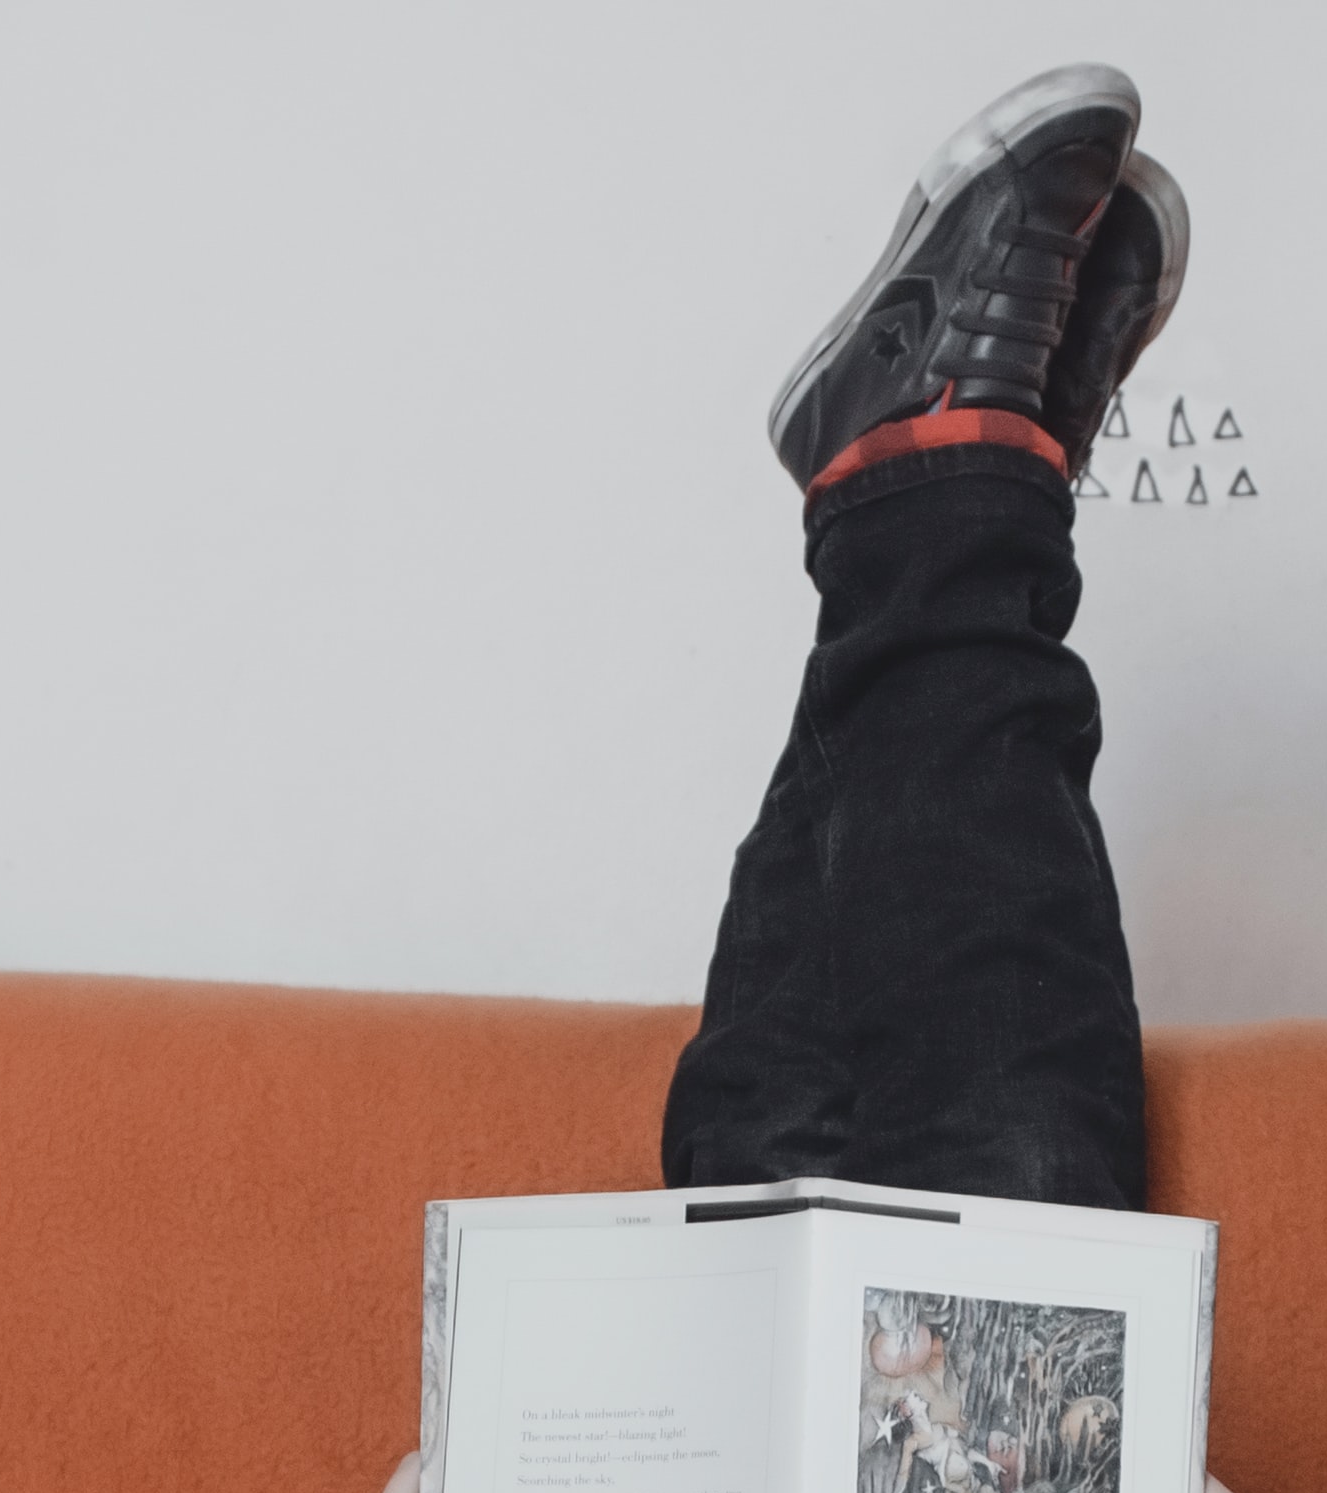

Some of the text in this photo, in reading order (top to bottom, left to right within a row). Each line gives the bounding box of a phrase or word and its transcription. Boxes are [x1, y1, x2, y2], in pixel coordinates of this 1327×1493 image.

[522, 1406, 674, 1420] On a bleak midwinter's night
[521, 1431, 540, 1442] The
[545, 1432, 581, 1442] newest
[519, 1454, 532, 1464] So
[535, 1453, 571, 1466] crystal
[672, 1449, 688, 1460] the
[517, 1475, 571, 1487] Scorching
[575, 1475, 591, 1485] the
